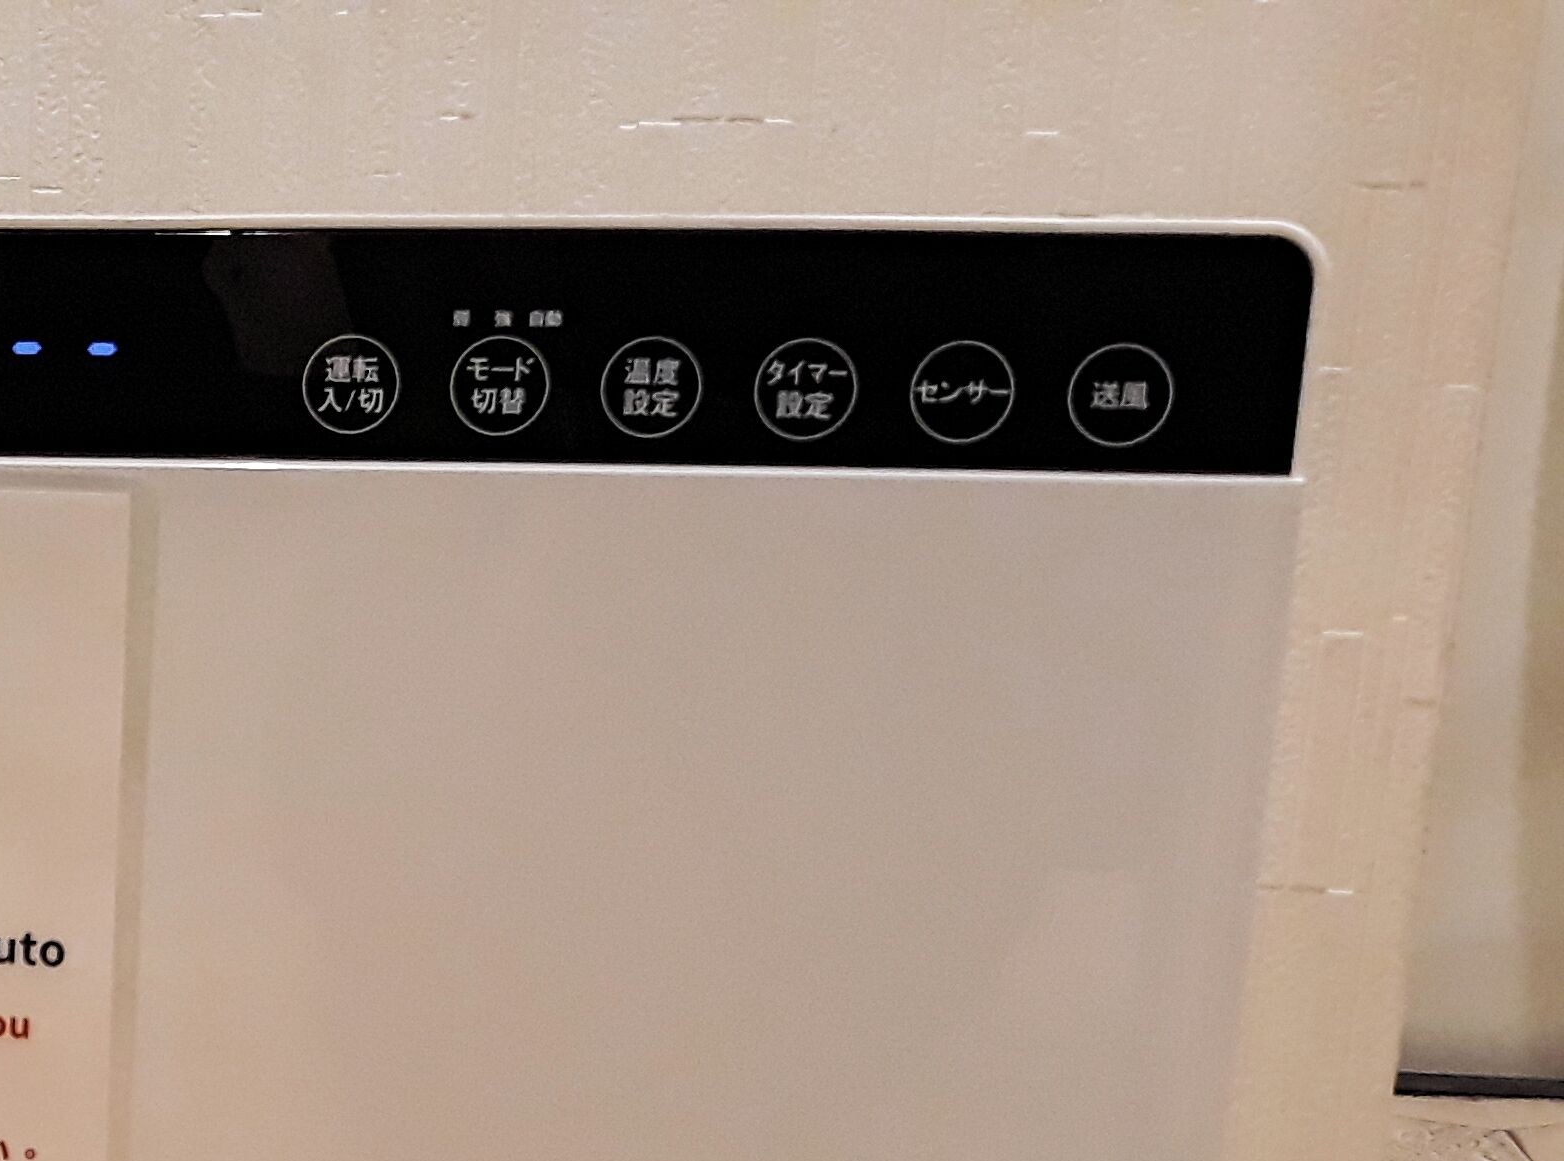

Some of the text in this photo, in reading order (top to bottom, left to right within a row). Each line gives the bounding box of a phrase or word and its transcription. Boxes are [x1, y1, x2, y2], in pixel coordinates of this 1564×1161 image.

[467, 357, 535, 382] モード
[767, 360, 848, 385] タイマー
[318, 388, 384, 413] 入/切
[915, 379, 1011, 405] センサー
